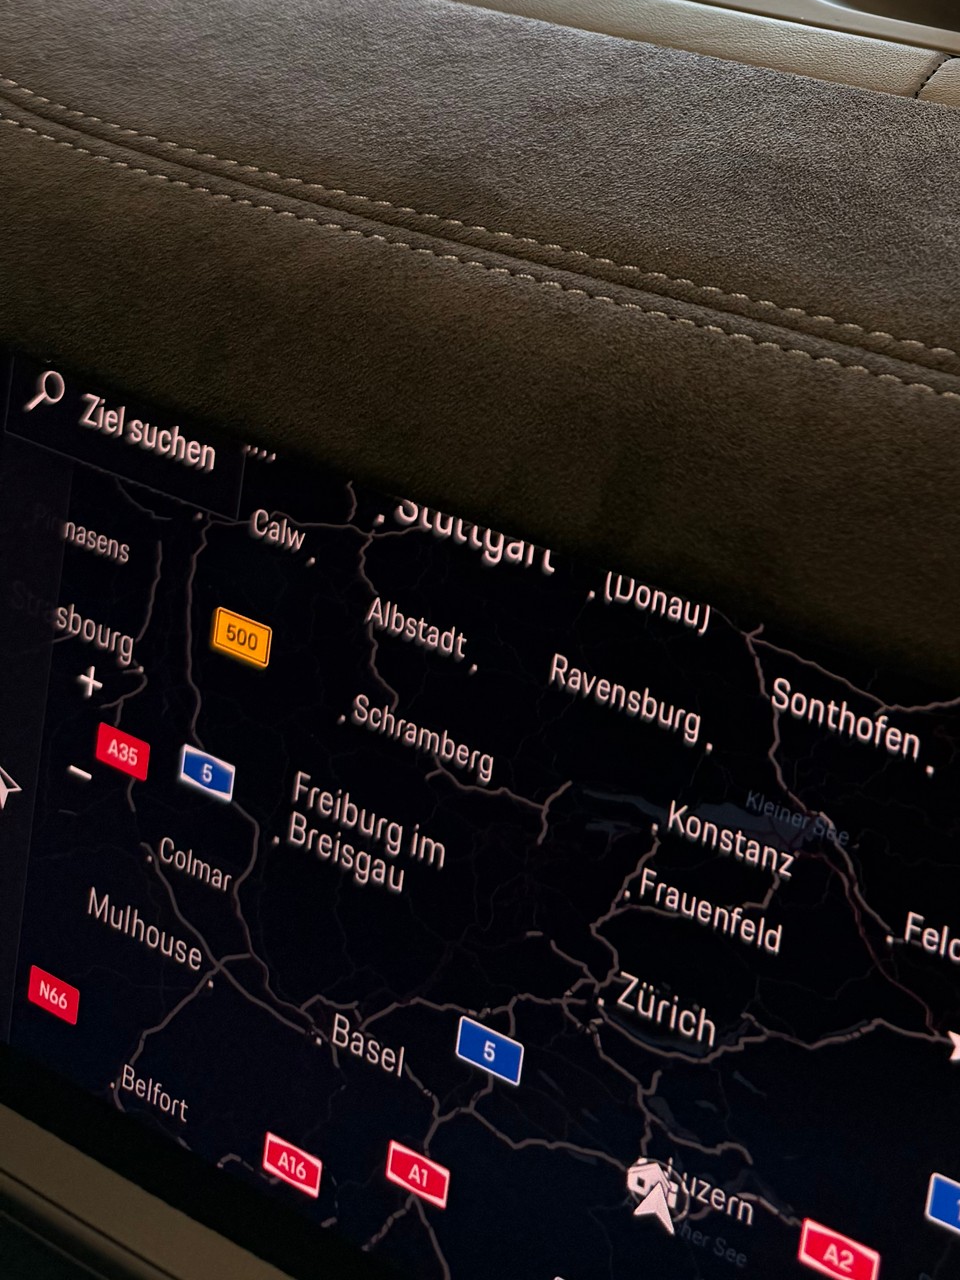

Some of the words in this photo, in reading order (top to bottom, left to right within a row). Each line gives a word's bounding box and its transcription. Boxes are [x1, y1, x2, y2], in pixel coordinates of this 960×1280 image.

[80, 393, 125, 437] Ziel
[130, 418, 216, 472] suchen
[252, 509, 306, 551] Calw
[225, 624, 259, 652] 500
[367, 597, 468, 660] Albstadt
[549, 654, 701, 746] Ravensburg
[771, 678, 921, 760] Sonthofen
[107, 739, 138, 766] A35
[352, 694, 494, 782] Schramberg
[201, 764, 213, 783] 5
[292, 771, 403, 852] Freiburg
[412, 824, 446, 871] im
[668, 800, 795, 878] Konstanz
[746, 790, 811, 829] Kleiner
[813, 816, 850, 846] See
[159, 836, 232, 893] Colmar
[289, 812, 405, 893] Breisgau
[87, 886, 202, 971] Mulhouse
[640, 868, 783, 955] Frauenfeld
[39, 980, 68, 1010] N66
[616, 971, 717, 1048] Zürich
[332, 1013, 405, 1077] Basel
[483, 1041, 495, 1063] 5
[121, 1065, 189, 1123] Belfort
[278, 1151, 307, 1180] A16
[408, 1165, 428, 1188] A1
[666, 1157, 754, 1226] uzern
[713, 1237, 748, 1267] See
[823, 1243, 855, 1274] A2
